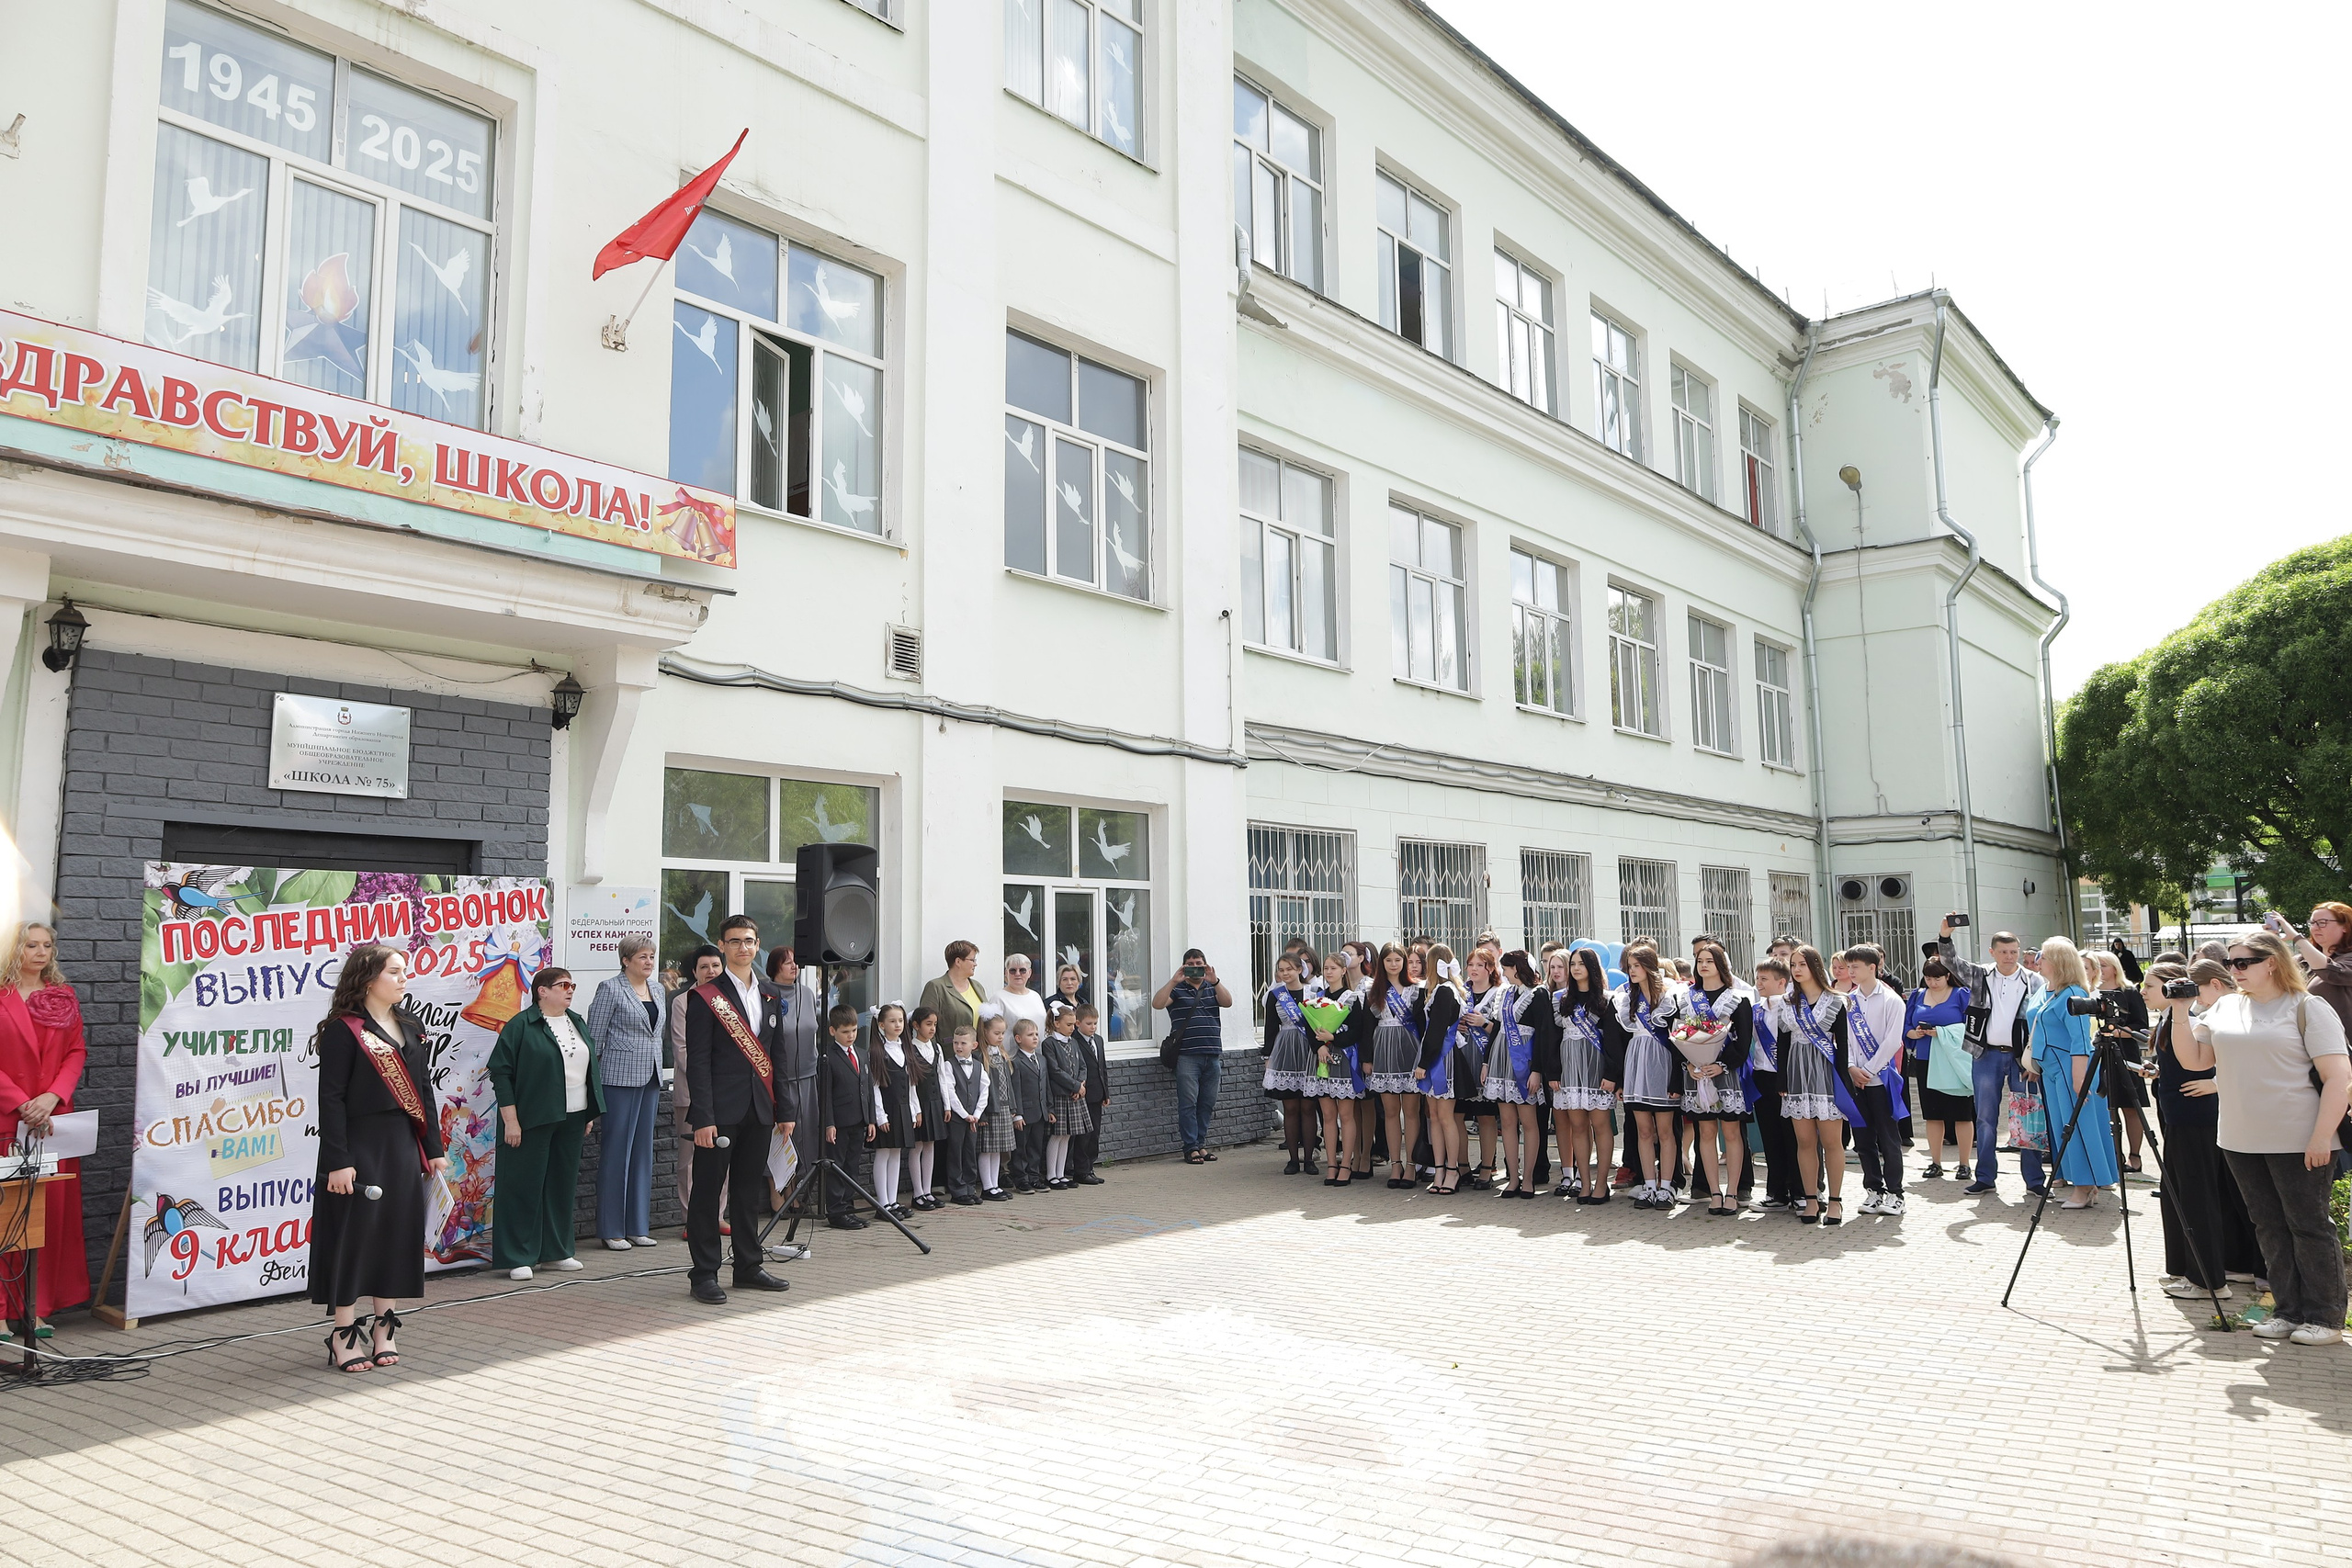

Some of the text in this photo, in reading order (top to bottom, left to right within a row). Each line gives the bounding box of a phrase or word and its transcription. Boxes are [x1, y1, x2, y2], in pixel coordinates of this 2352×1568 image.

[169, 41, 316, 131] 1945
[359, 114, 481, 194] 2025
[0, 340, 651, 531] ДРАВСТВУЙ, ШКОЛА!
[287, 742, 396, 758] МУНИЦИПАЛЬНОЕ БЮДЖЕТНОЕ
[299, 750, 384, 763] ОБЩЕОБРАЗОВАТЕЛЬНОЕ
[318, 759, 366, 768] УЧРЕЖДЕНИЕ
[283, 770, 396, 789] «ШКОЛА № 75»
[162, 887, 548, 963] ПОСЛЕДНИЙ ЗВОНОК
[571, 918, 625, 927] ФЕДЕРАЛЬНЫЙ
[571, 931, 653, 939] УСПЕХ КАЖО
[195, 958, 339, 1007] ВЫПУС
[163, 1028, 293, 1057] УЧИТЕЛЯ!
[752, 1052, 773, 1077] 2025
[175, 1063, 277, 1099] ВЫ ЛУЧШИЕ!
[146, 1097, 306, 1146] СПАСИБО
[221, 1134, 276, 1159] ВАМ!
[170, 1229, 199, 1280] 9
